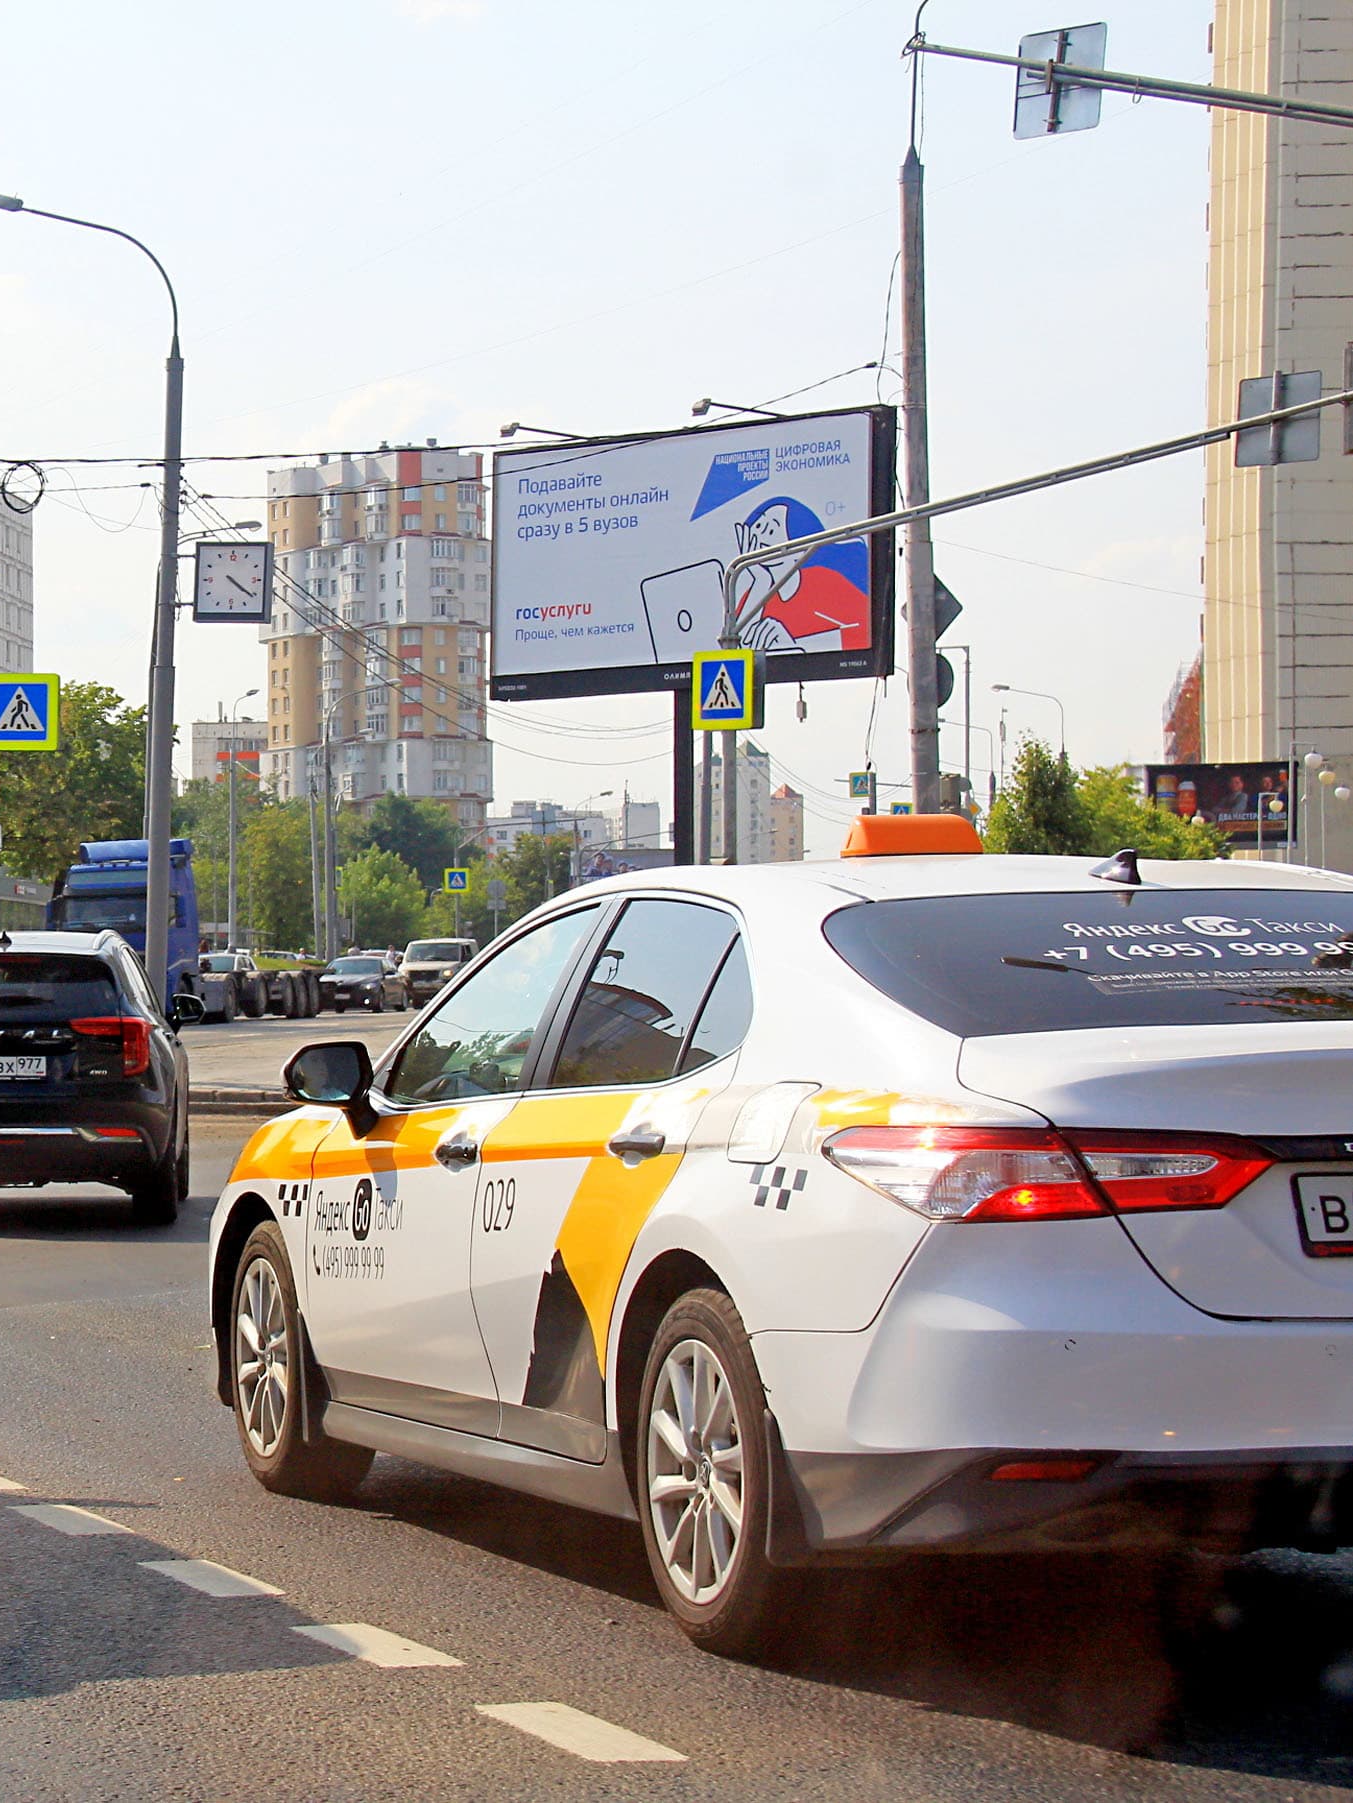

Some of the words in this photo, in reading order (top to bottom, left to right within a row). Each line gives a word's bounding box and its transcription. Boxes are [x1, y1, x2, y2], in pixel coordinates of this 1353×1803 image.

[775, 440, 841, 459] ЦИФРОВАЯ
[775, 453, 851, 473] ЭКОНОМИКА
[518, 472, 603, 496] Подавайте
[743, 471, 769, 481] РОССИИ
[517, 496, 606, 520] документы
[610, 486, 669, 507] онлайн
[825, 500, 847, 516] 0+
[517, 523, 560, 542] сразу
[565, 522, 573, 534] в
[578, 517, 589, 533] 5
[593, 515, 638, 535] вузов
[516, 603, 593, 621] госуслуги
[515, 629, 558, 643] Проще,
[561, 627, 584, 637] чем
[587, 623, 635, 635] кажется
[1062, 922, 1186, 939] Яндекс
[1244, 918, 1346, 935] Такси
[1044, 945, 1088, 960] +7
[1106, 942, 1222, 961] (495)
[1228, 941, 1309, 957] 999
[1213, 970, 1250, 979] App
[1252, 969, 1301, 978] Store
[18, 1058, 42, 1069] 977
[314, 1190, 351, 1237] Яндекс
[353, 1187, 371, 1232] Go
[374, 1187, 403, 1232] Такси
[482, 1178, 516, 1233] 029
[322, 1245, 343, 1280] (495)
[344, 1245, 359, 1280] 999
[361, 1246, 372, 1279] 99
[374, 1246, 385, 1279] 99
